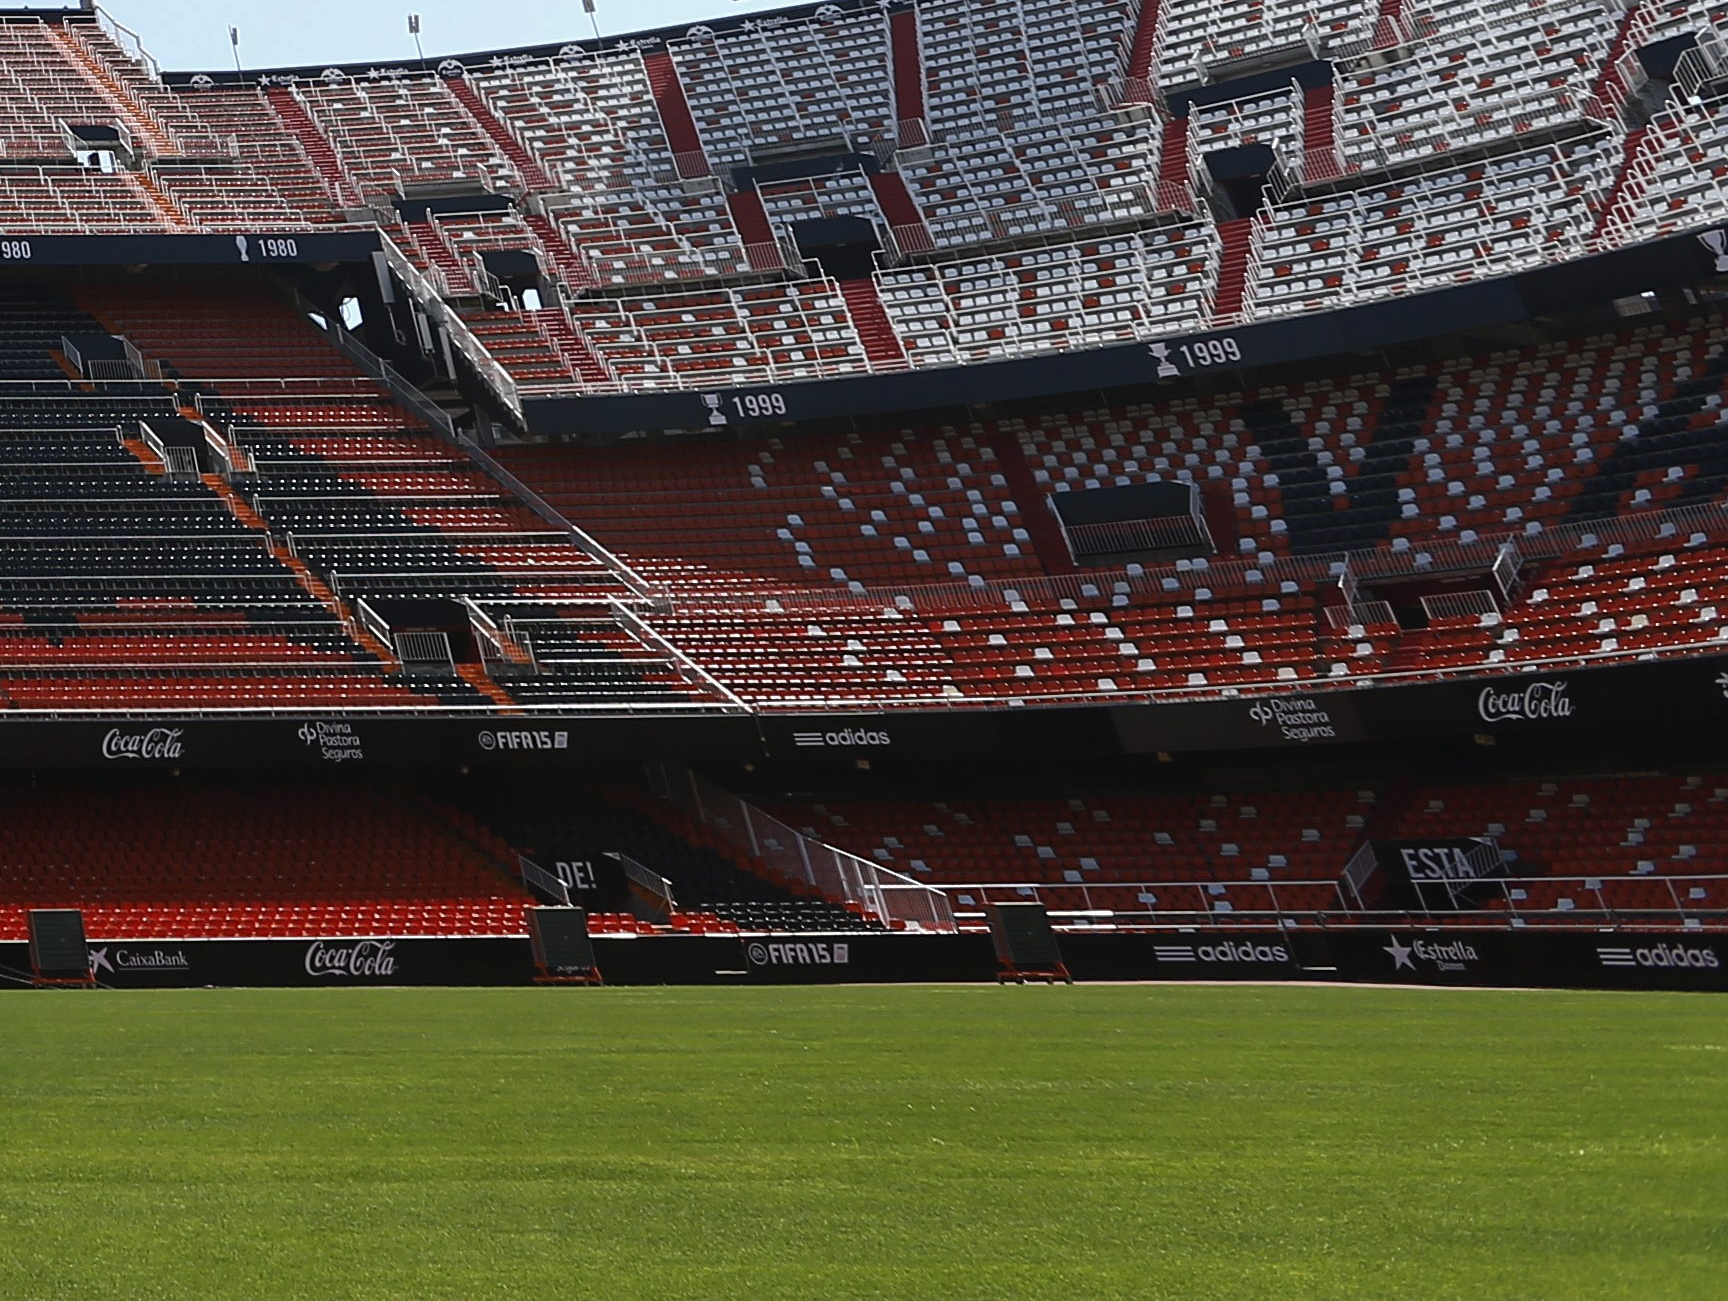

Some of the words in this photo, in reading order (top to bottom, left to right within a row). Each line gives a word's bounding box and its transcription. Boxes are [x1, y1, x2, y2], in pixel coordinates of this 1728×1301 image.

[258, 239, 297, 256] 1980
[1180, 338, 1240, 367] 1999
[733, 394, 786, 417] 1999
[1272, 699, 1316, 711] Divina
[1277, 711, 1331, 725] Pastora
[316, 723, 351, 735] Divina
[826, 728, 890, 745] adidas
[1283, 723, 1335, 740] Seguros
[319, 735, 360, 747] Pastora
[322, 748, 363, 762] Seguros
[1401, 848, 1474, 879] ESTA
[555, 861, 598, 890] DE!
[116, 950, 187, 966] CaixaBank
[1198, 941, 1288, 961] adidas
[1414, 940, 1478, 961] Estrella
[1637, 943, 1719, 967] adidas
